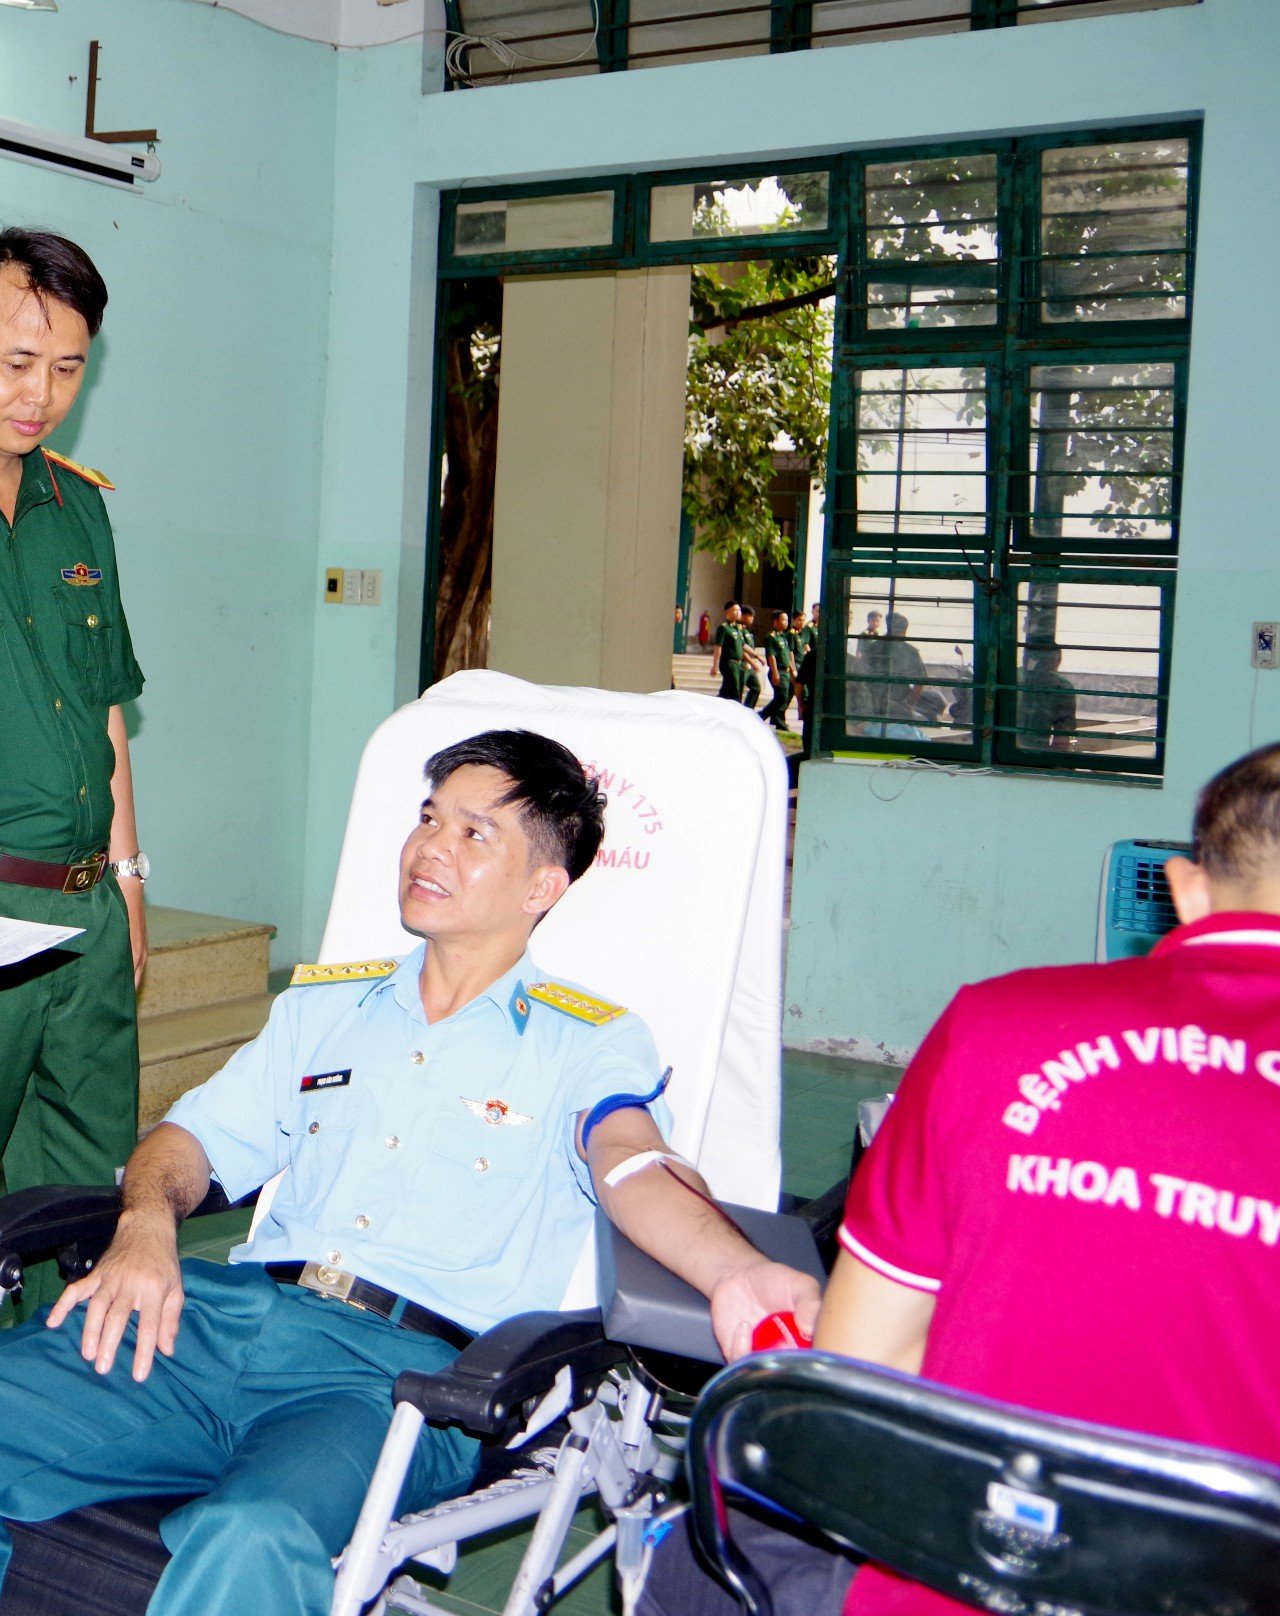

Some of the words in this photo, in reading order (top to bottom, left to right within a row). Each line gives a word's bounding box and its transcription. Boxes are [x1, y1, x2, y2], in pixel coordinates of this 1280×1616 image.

[616, 778, 635, 797] Y
[631, 794, 664, 835] 175
[595, 846, 651, 870] MÁU
[1001, 1034, 1121, 1136] BỆNH
[1121, 1024, 1248, 1075] VIỆN
[1006, 1153, 1142, 1212] KHOA
